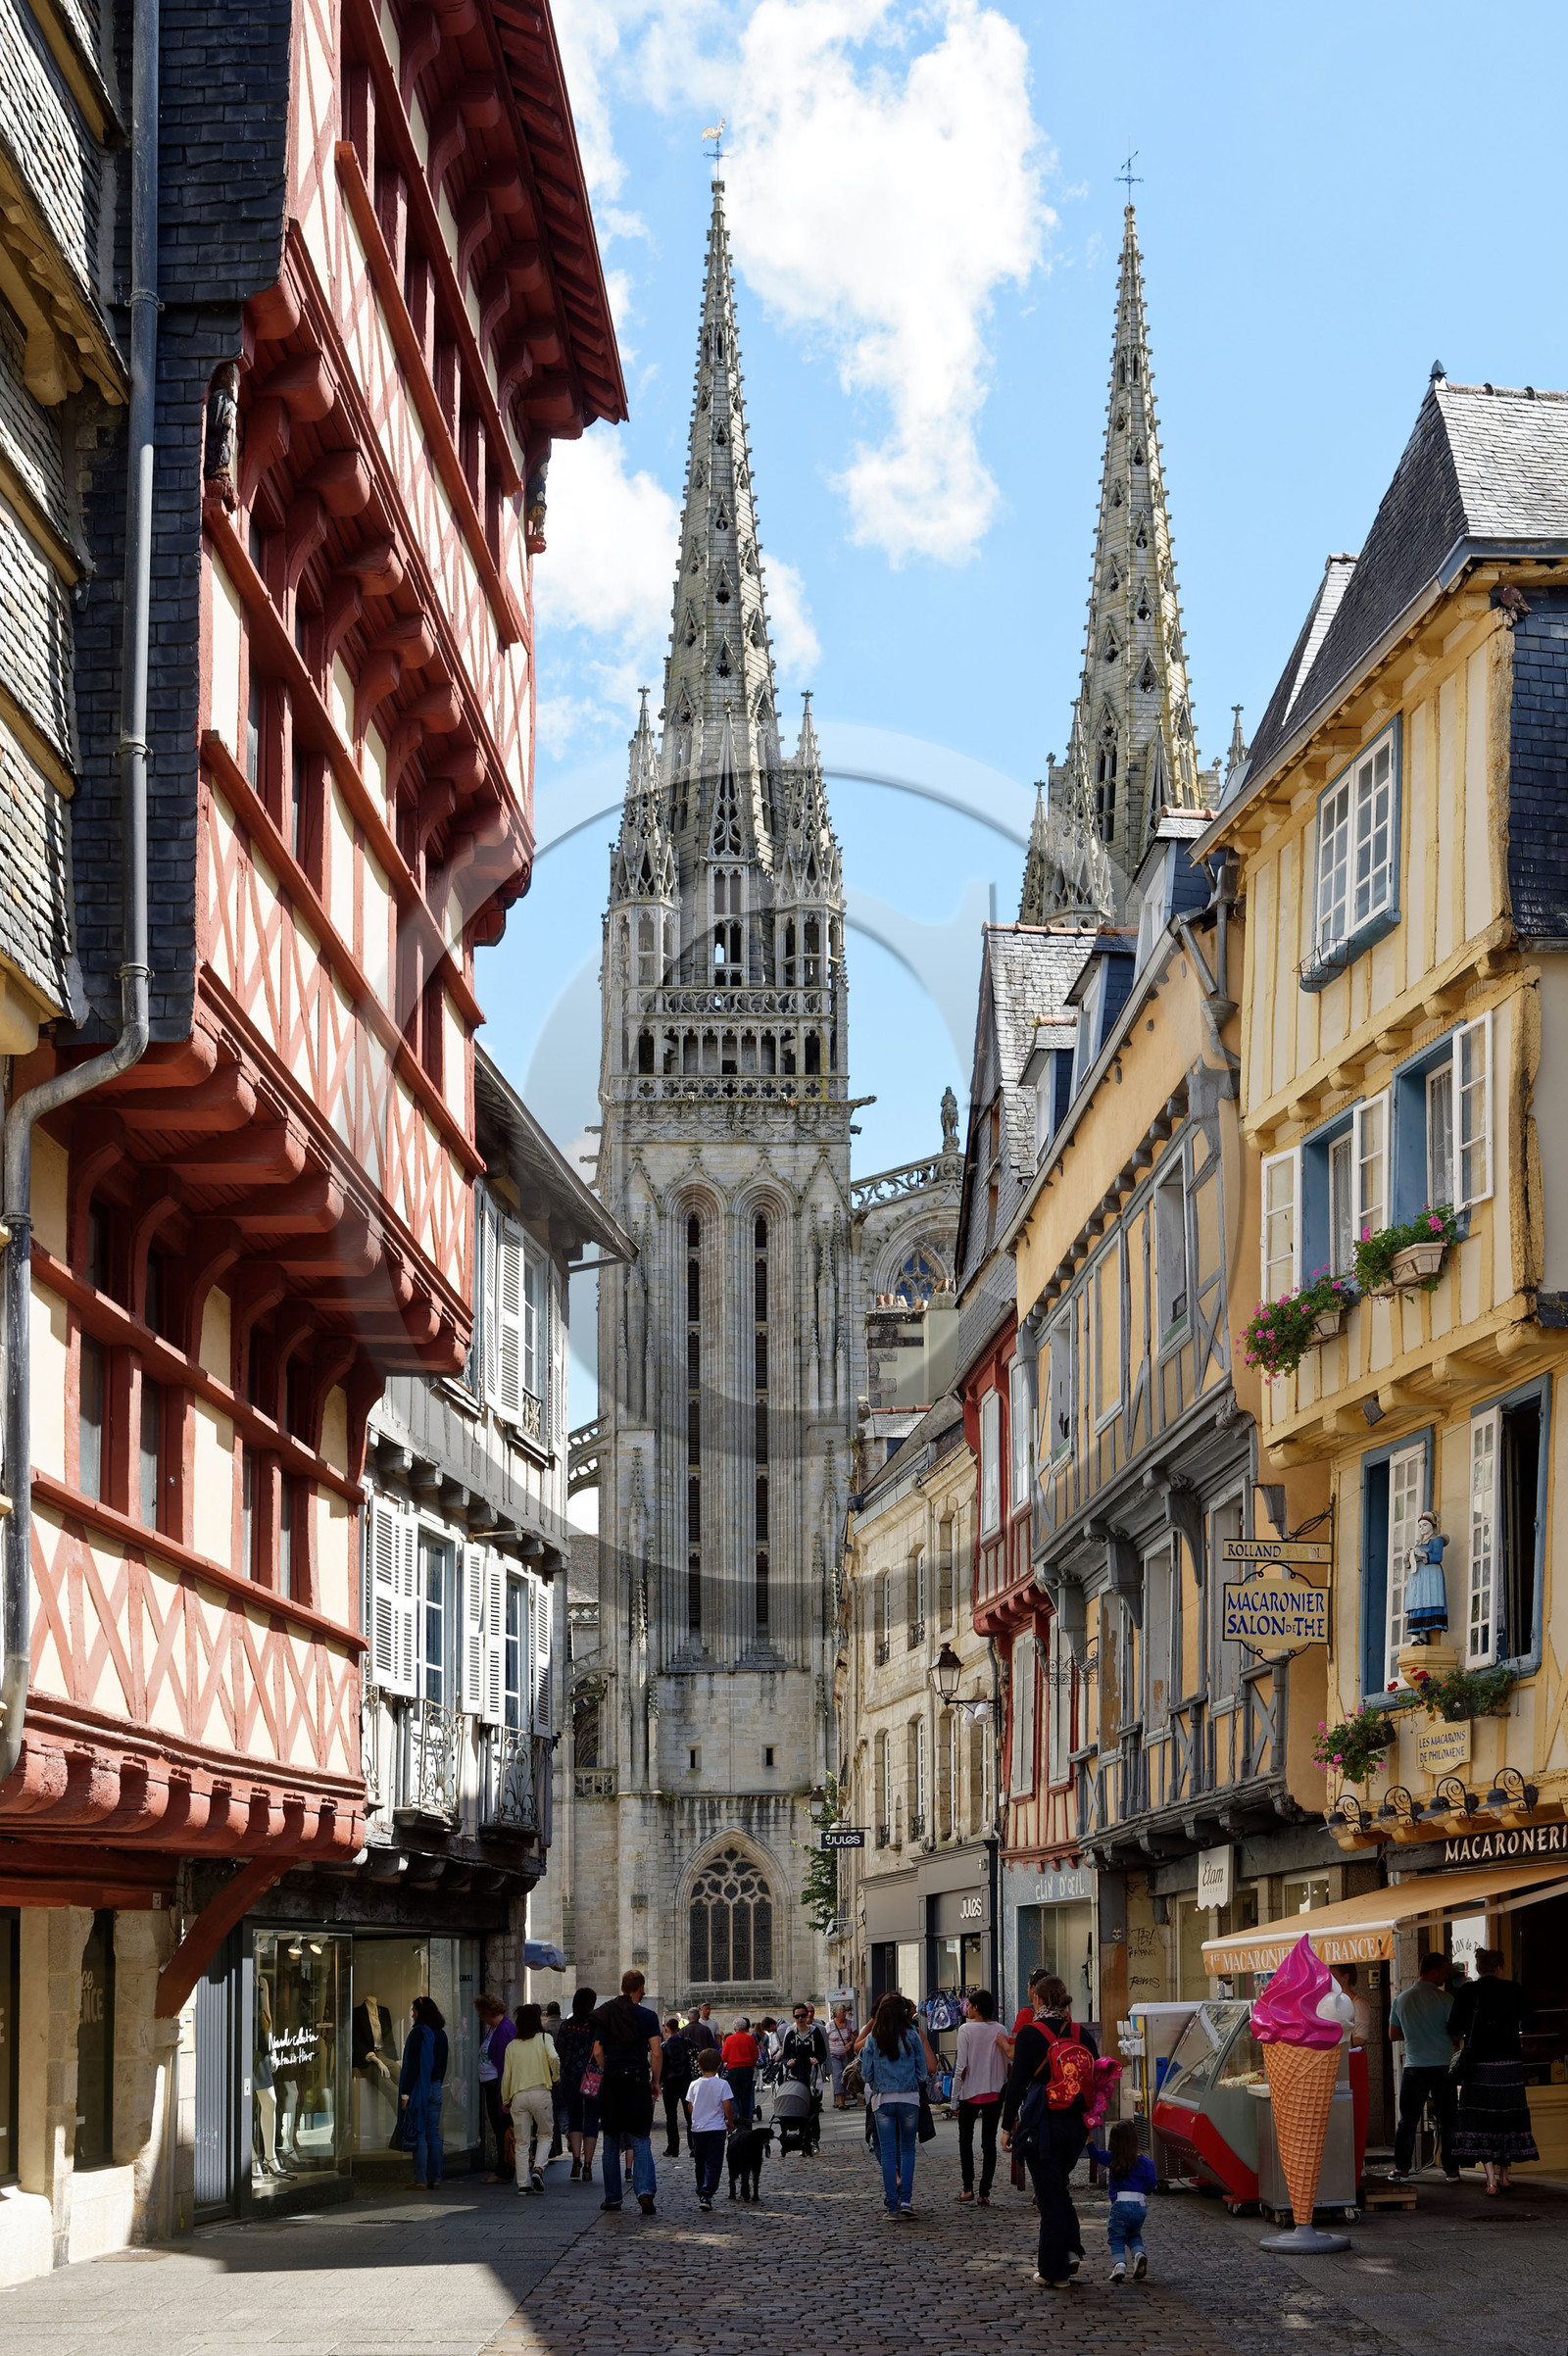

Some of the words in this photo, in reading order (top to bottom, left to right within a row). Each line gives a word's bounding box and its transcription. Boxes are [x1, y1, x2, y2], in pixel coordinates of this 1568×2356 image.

[1228, 1544, 1281, 1557] ROLLAND
[1227, 1592, 1325, 1612] MACARONIER
[1227, 1614, 1286, 1636] SALON
[1286, 1624, 1296, 1634] DE
[1294, 1617, 1326, 1638] THE
[1419, 1738, 1430, 1748] LES
[1431, 1731, 1466, 1746] MACARONS
[1419, 1752, 1428, 1762] DE
[1429, 1745, 1465, 1761] PHILOMENE
[1202, 1861, 1224, 1887] Etam
